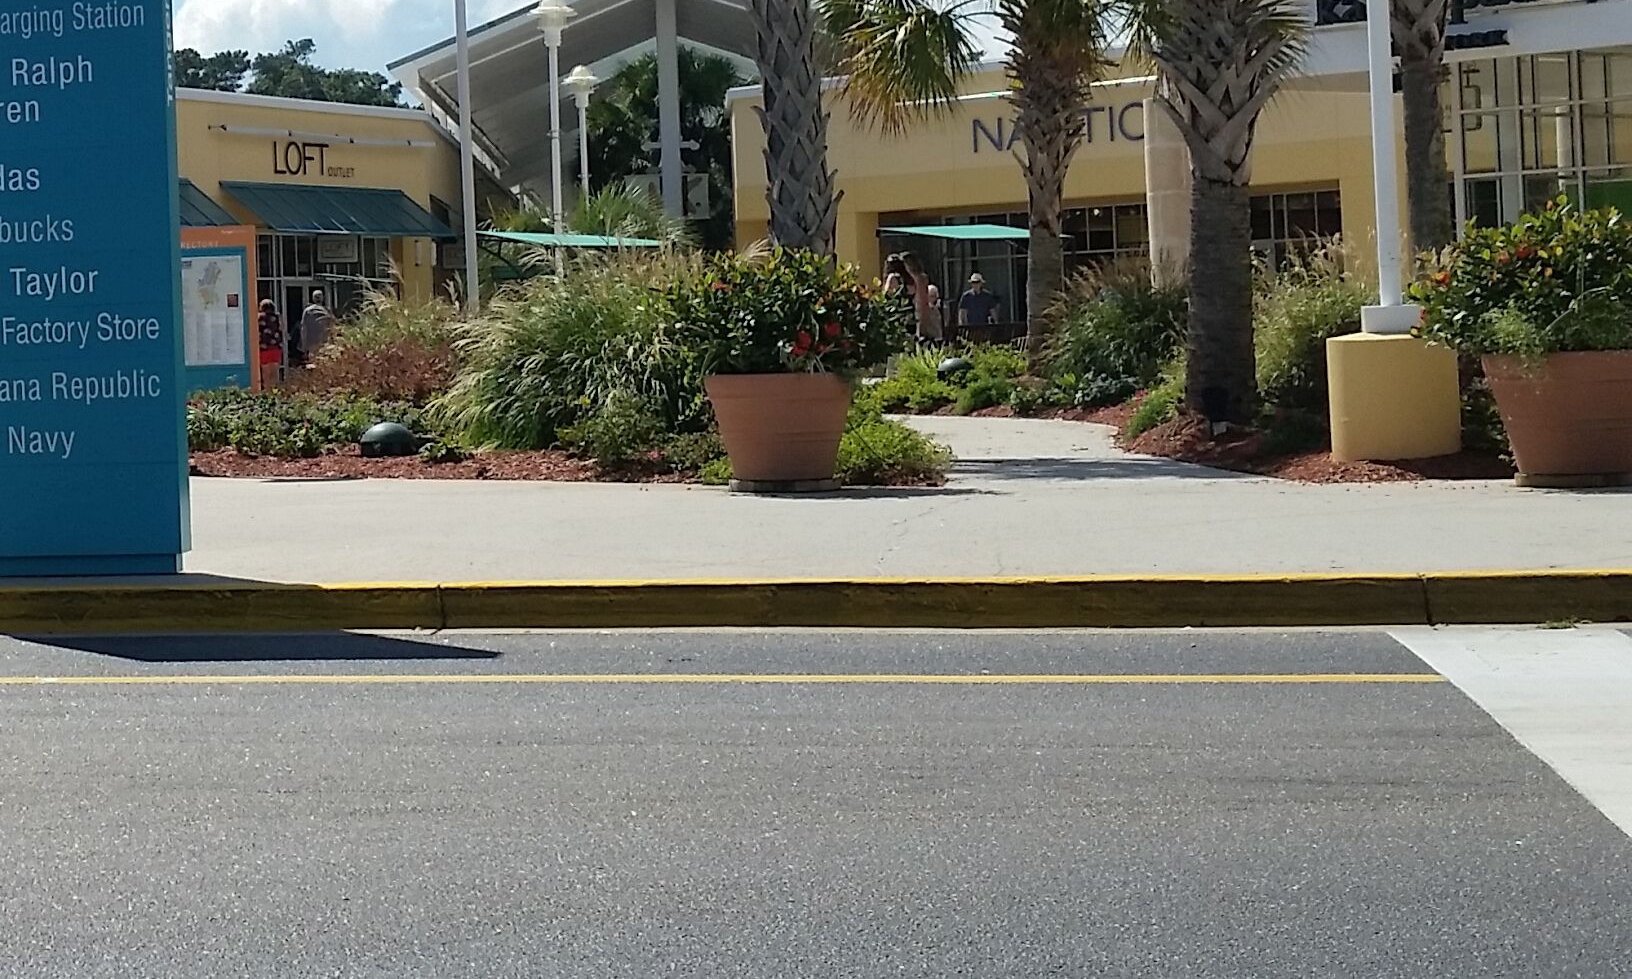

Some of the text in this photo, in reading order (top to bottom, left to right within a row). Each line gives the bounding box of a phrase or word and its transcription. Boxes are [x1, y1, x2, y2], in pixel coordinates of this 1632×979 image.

[72, 0, 145, 31] Station
[11, 55, 94, 92] Ralph
[972, 101, 1144, 153] NTIC
[273, 140, 355, 178] LOFT OUTLET
[9, 265, 99, 300] Taylor
[1, 316, 91, 349] Factory
[96, 312, 160, 341] Store
[52, 369, 161, 405] Republic
[8, 426, 76, 459] Navy
